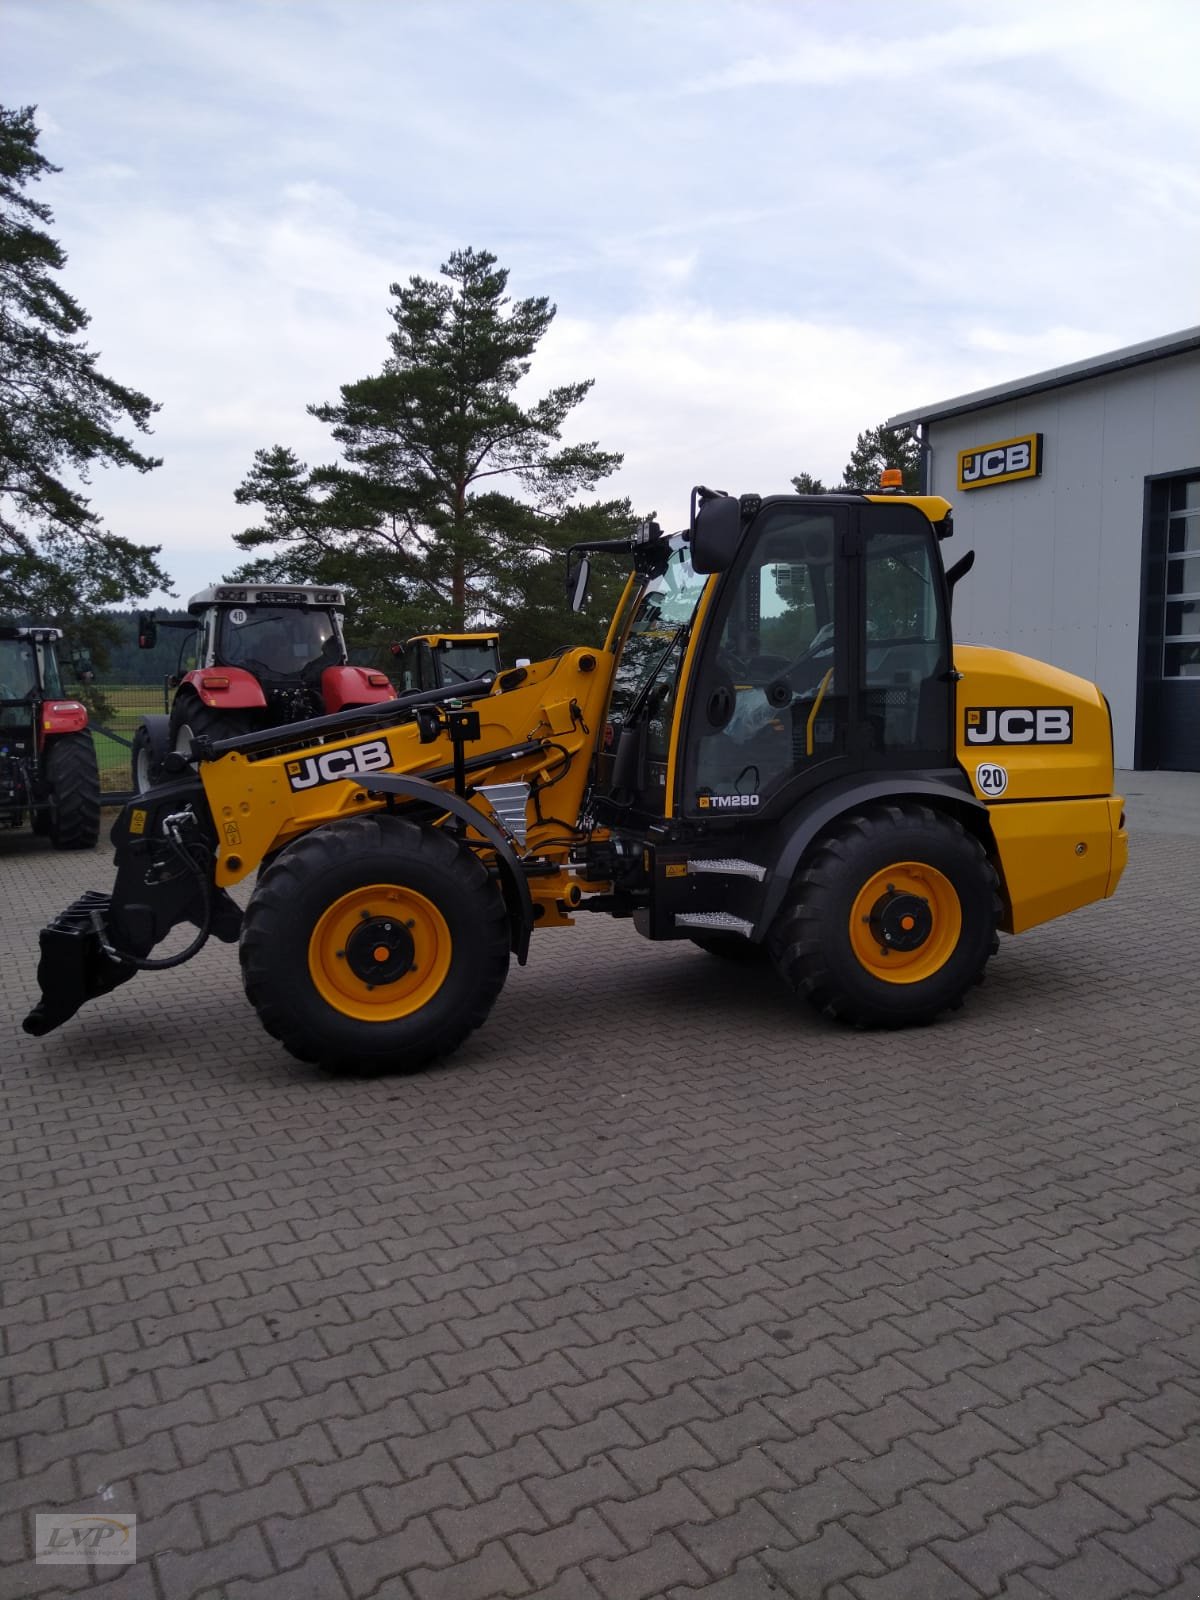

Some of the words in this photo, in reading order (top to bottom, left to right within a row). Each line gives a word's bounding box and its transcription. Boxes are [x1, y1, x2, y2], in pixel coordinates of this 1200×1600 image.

[964, 444, 1029, 480] JCB
[967, 709, 1070, 742] JCB
[291, 741, 391, 789] JCB
[982, 769, 1003, 788] 20
[710, 794, 759, 807] TM280
